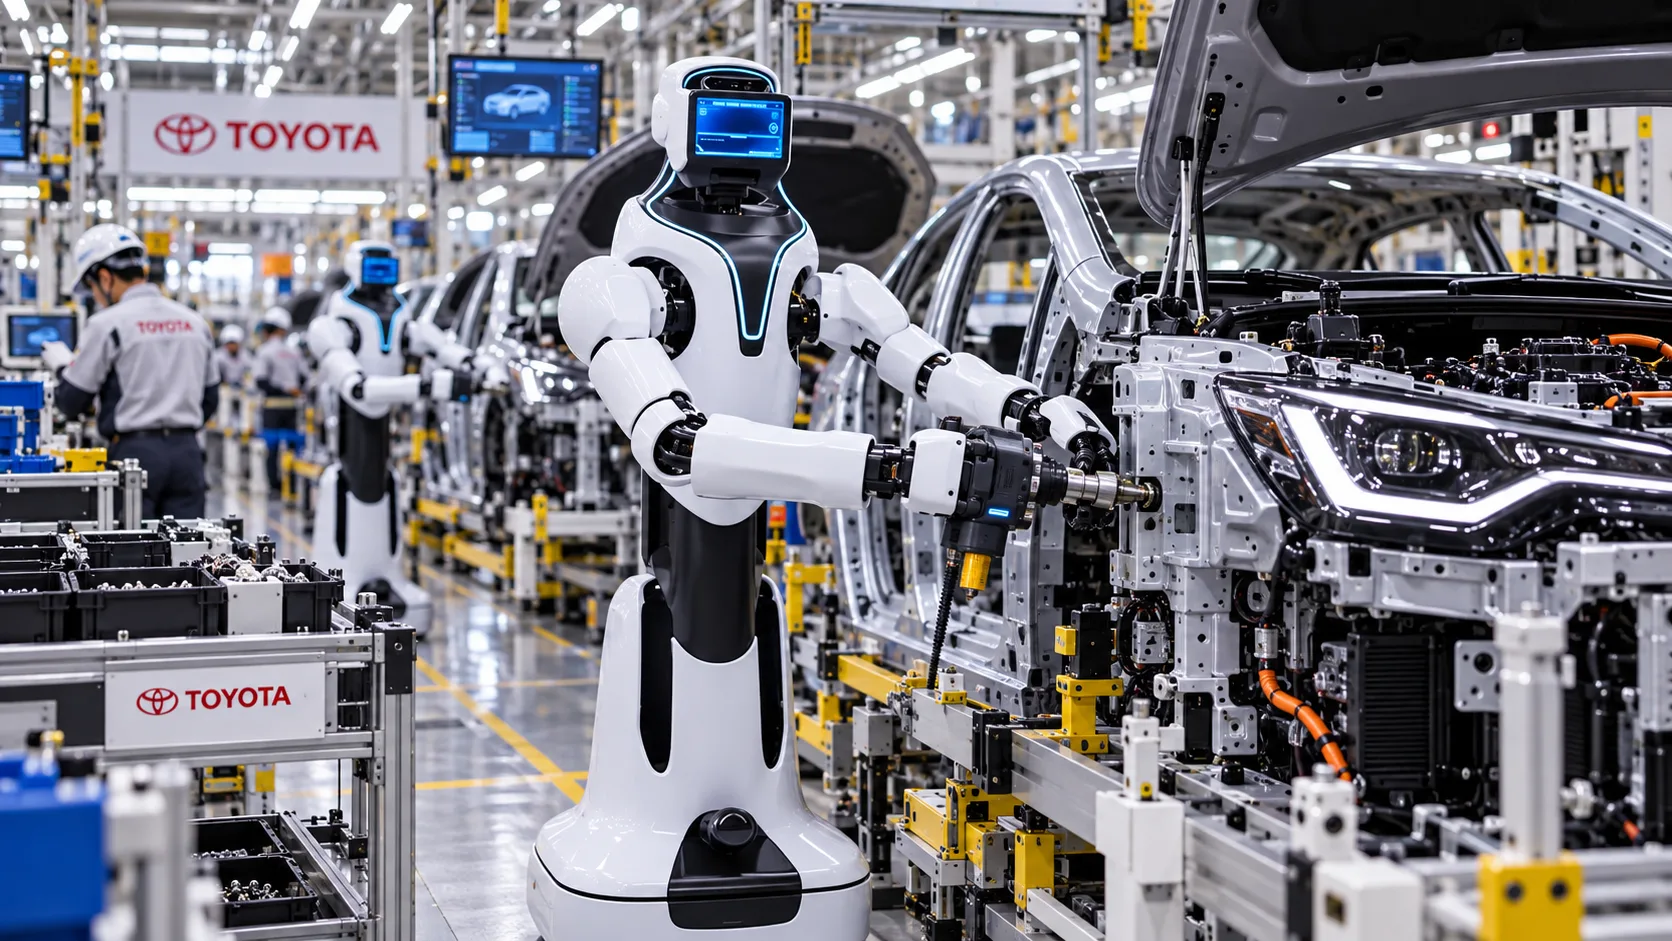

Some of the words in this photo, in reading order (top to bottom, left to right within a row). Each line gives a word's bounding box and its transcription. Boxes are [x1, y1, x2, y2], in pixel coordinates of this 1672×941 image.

[226, 121, 380, 152] TOYOTA
[137, 320, 193, 334] TOYOTA
[185, 685, 291, 711] TOYOTA
